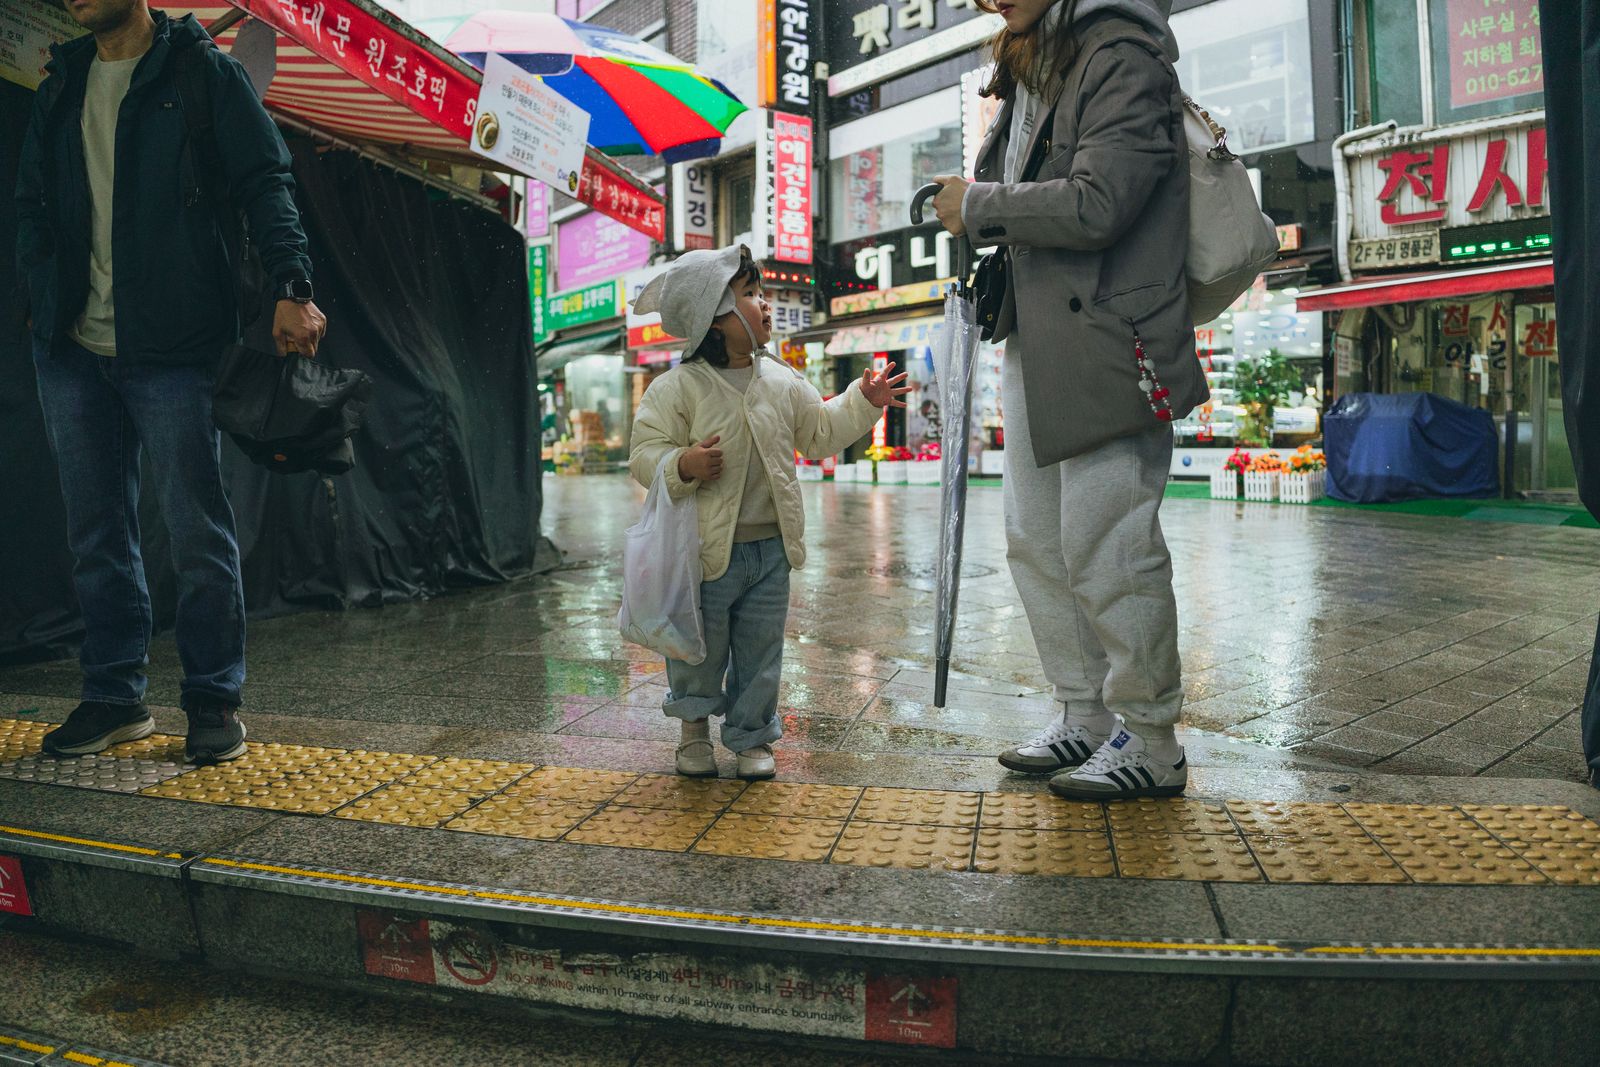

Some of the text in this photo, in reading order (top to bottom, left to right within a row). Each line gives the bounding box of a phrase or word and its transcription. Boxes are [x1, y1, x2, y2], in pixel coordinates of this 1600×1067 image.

[1459, 10, 1515, 39] 사무실
[278, 0, 447, 112] 남대문 원조호떡
[780, 0, 809, 105] 안경원
[1462, 35, 1542, 68] 지하철 최
[1354, 244, 1372, 263] 2F
[1375, 242, 1396, 261] 수입
[1400, 238, 1433, 259] 명품관
[0, 897, 13, 908] 0m
[391, 963, 410, 975] 10m
[505, 972, 521, 984] NO
[524, 975, 574, 991] SMOKING
[577, 982, 609, 995] within
[612, 987, 660, 1003] 10-meter
[664, 993, 675, 1004] of
[678, 994, 691, 1005] all
[694, 998, 735, 1012] subway
[738, 1003, 788, 1017] entrance
[776, 977, 856, 1005] 금연구역
[897, 1026, 922, 1039] 10m
